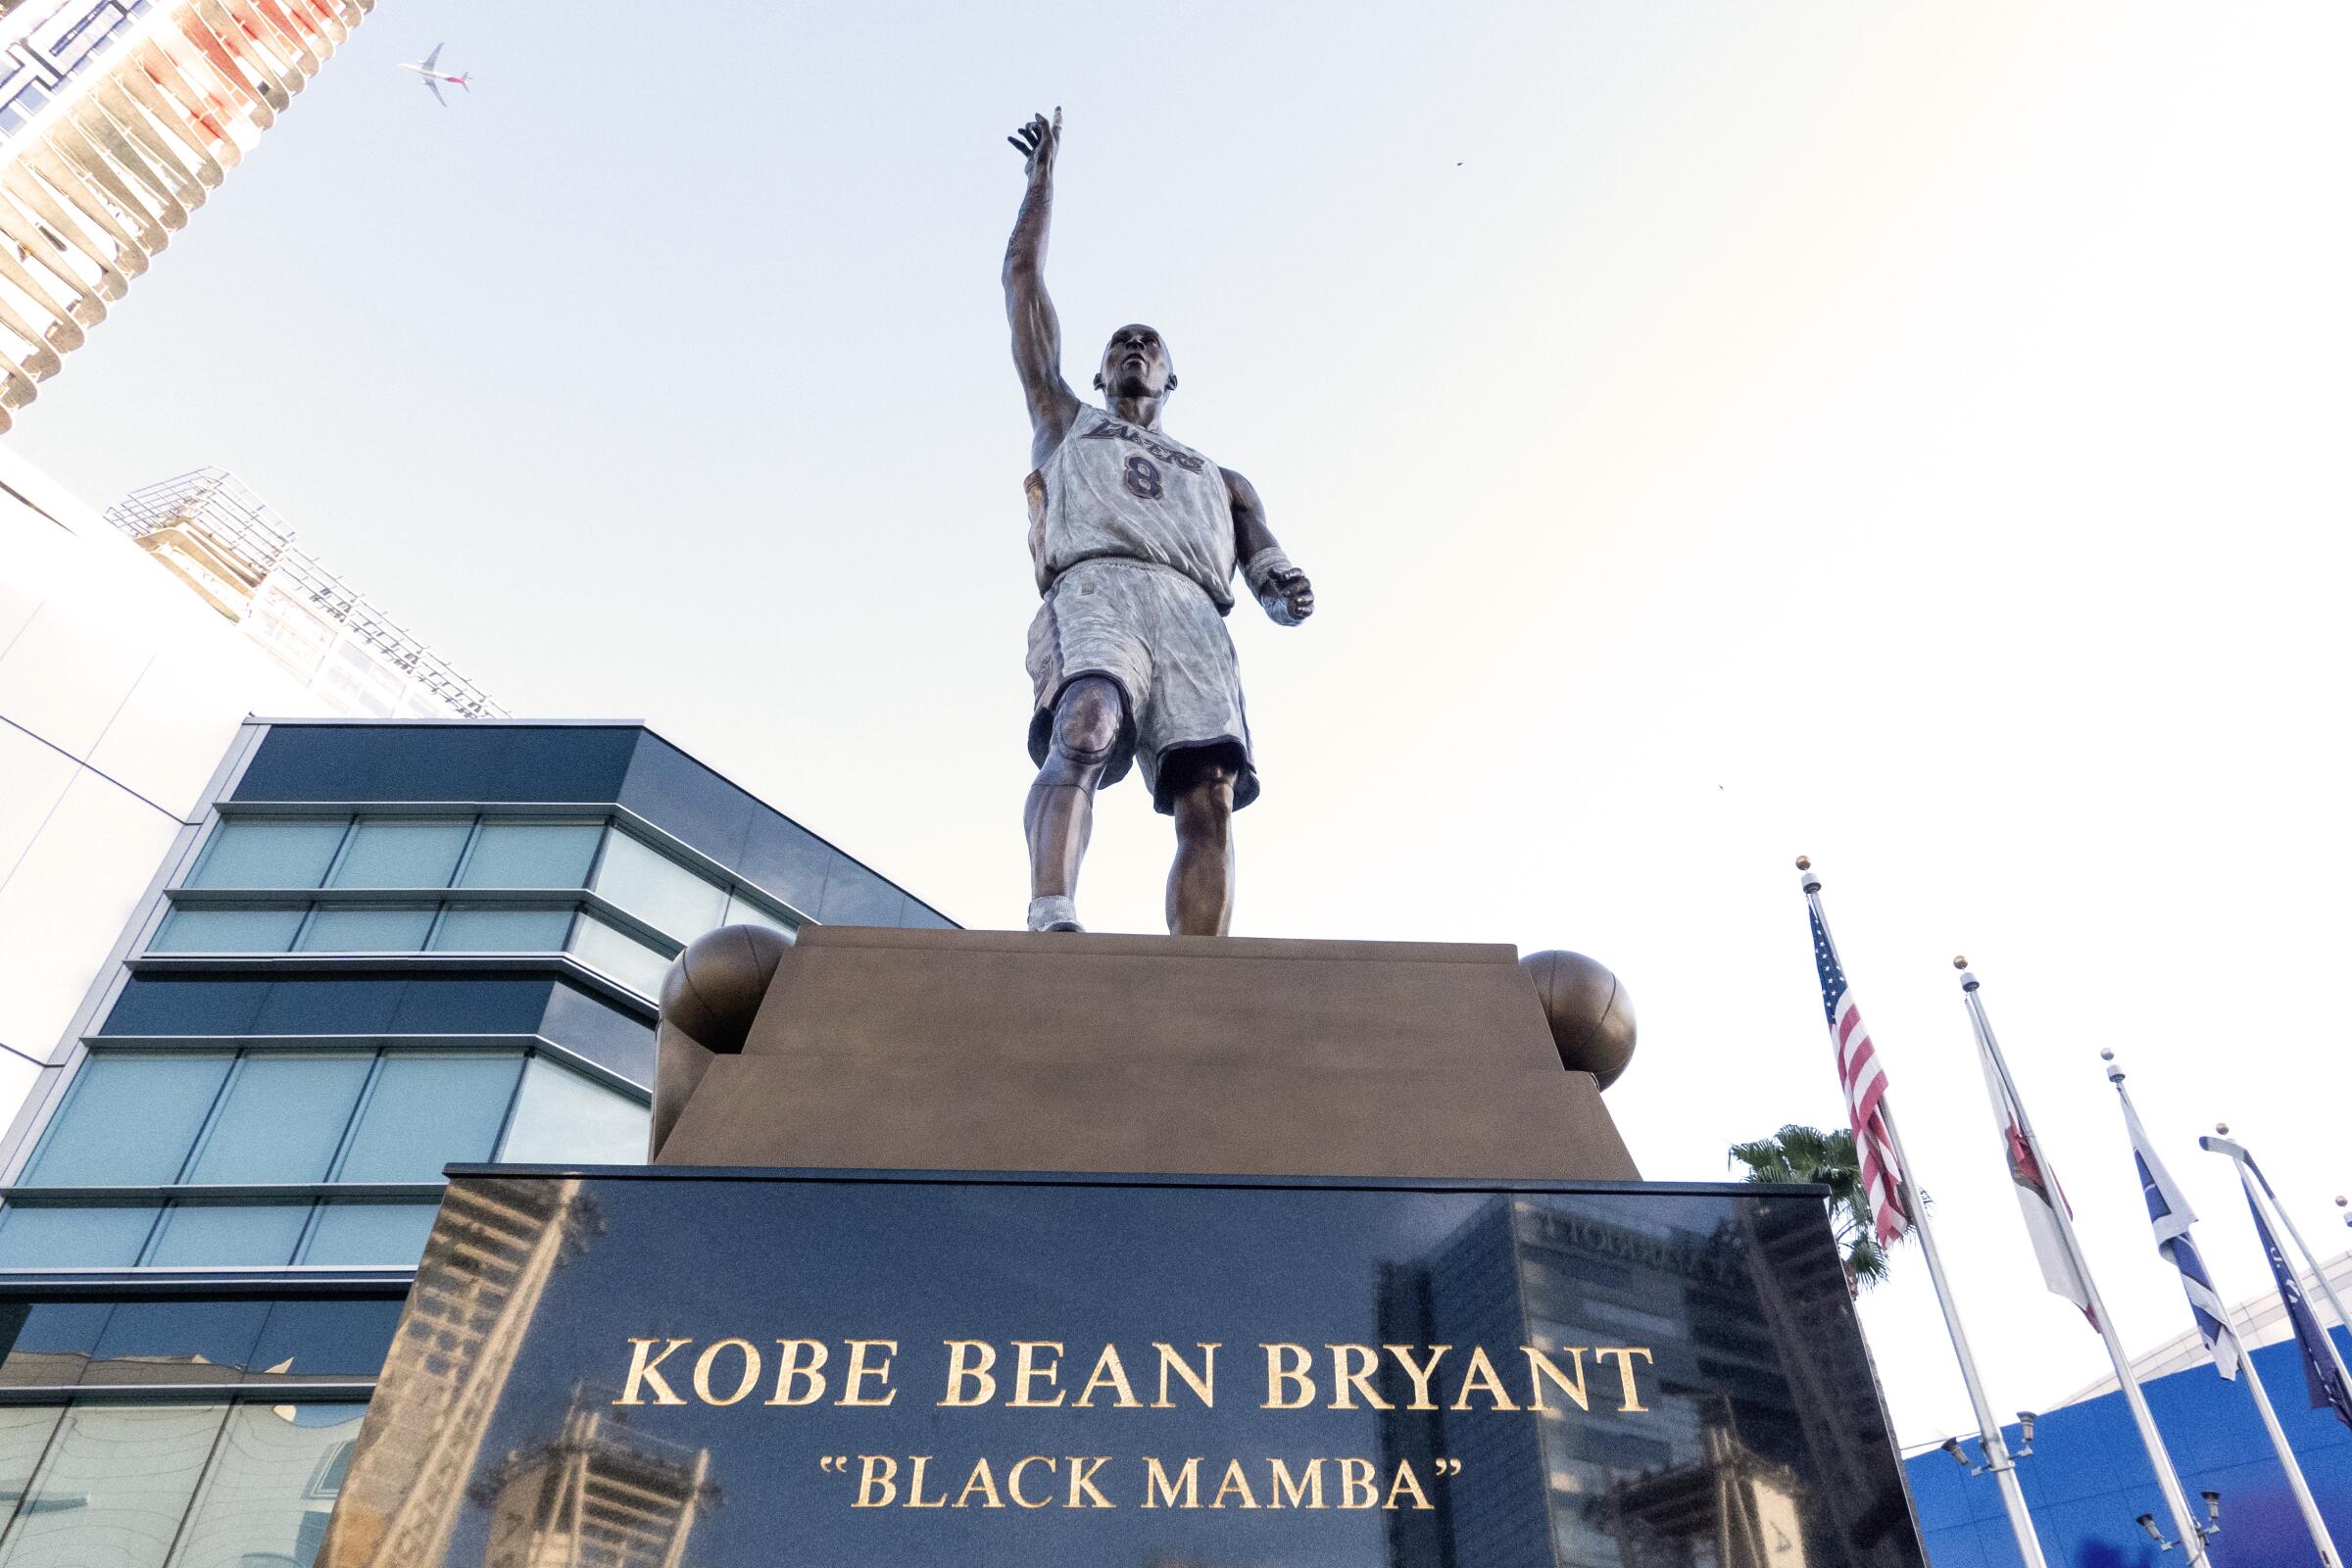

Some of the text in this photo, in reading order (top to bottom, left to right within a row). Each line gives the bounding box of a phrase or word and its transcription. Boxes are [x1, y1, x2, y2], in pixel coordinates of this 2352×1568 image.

[1124, 455, 1164, 501] 8
[612, 1337, 1654, 1413] KOBE BEAN BRYANT
[820, 1454, 1463, 1510] “BLACK MAMBA”
